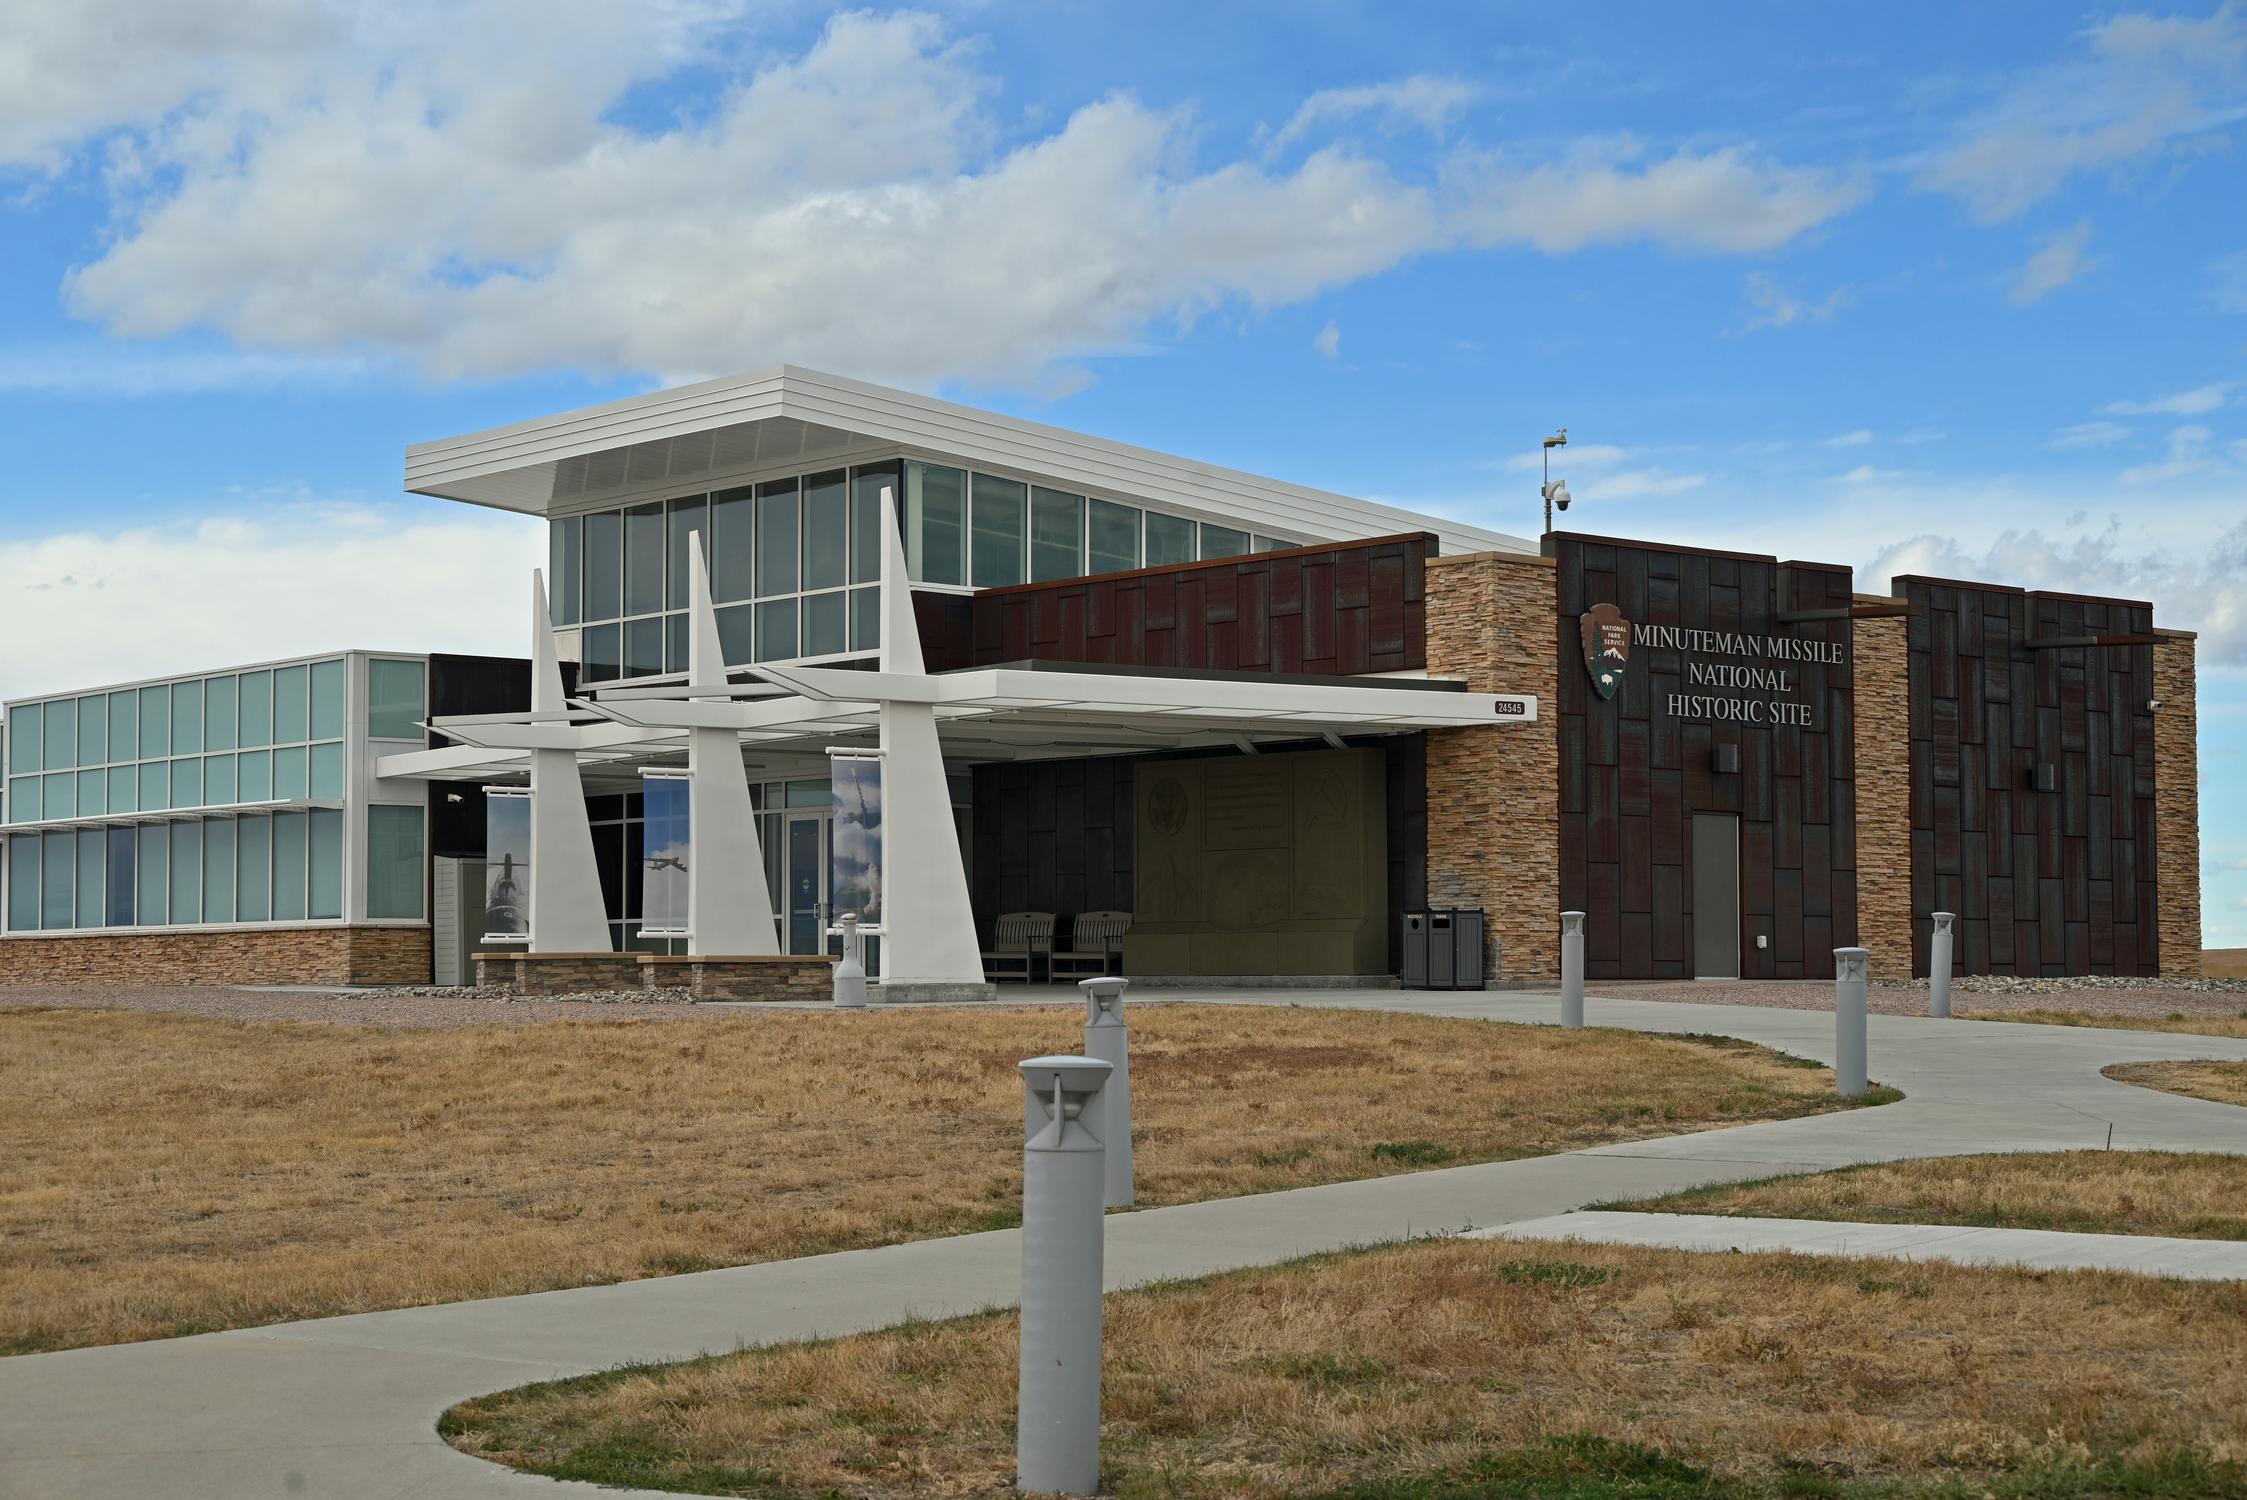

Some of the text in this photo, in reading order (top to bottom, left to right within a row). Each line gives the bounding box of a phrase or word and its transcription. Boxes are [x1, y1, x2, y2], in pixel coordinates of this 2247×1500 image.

[1601, 624, 1627, 633] NATIONAL
[1603, 638, 1625, 646] SERVICE
[1633, 623, 1844, 664] MINUTEMAN MISSILE
[1689, 662, 1792, 692] NATIONAL
[1498, 702, 1522, 713] 24545
[1666, 693, 1812, 726] HISTORIC SITE
